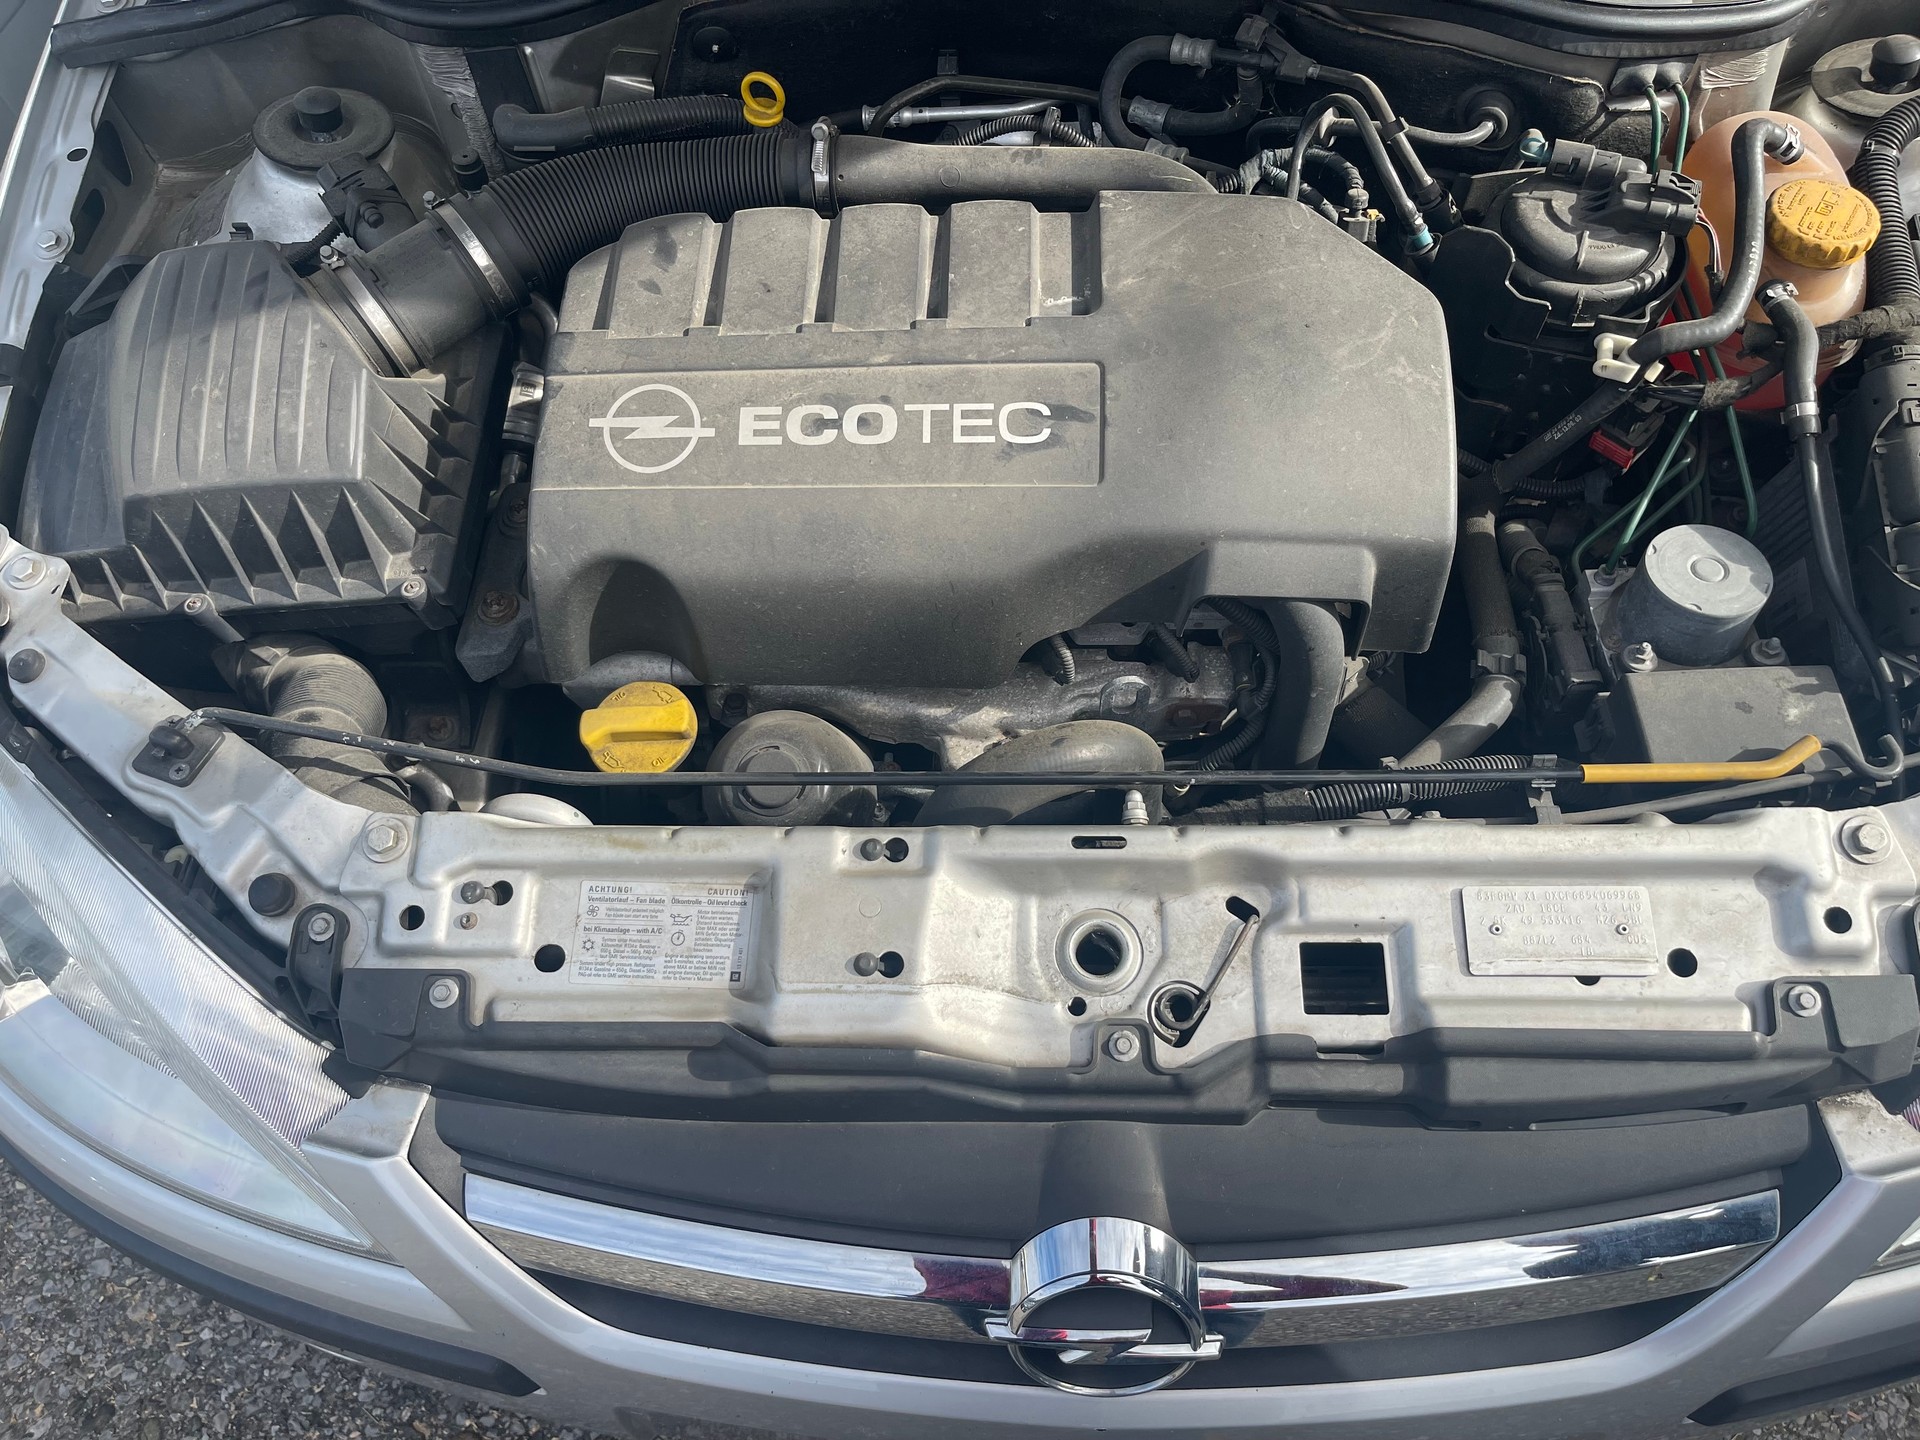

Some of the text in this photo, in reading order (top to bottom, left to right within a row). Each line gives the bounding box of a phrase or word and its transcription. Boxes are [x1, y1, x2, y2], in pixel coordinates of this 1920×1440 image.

[738, 401, 1052, 446] ECOTEC
[651, 756, 671, 768] OIL
[708, 888, 749, 896] CAUTION!
[594, 926, 630, 935] Klimaanlage
